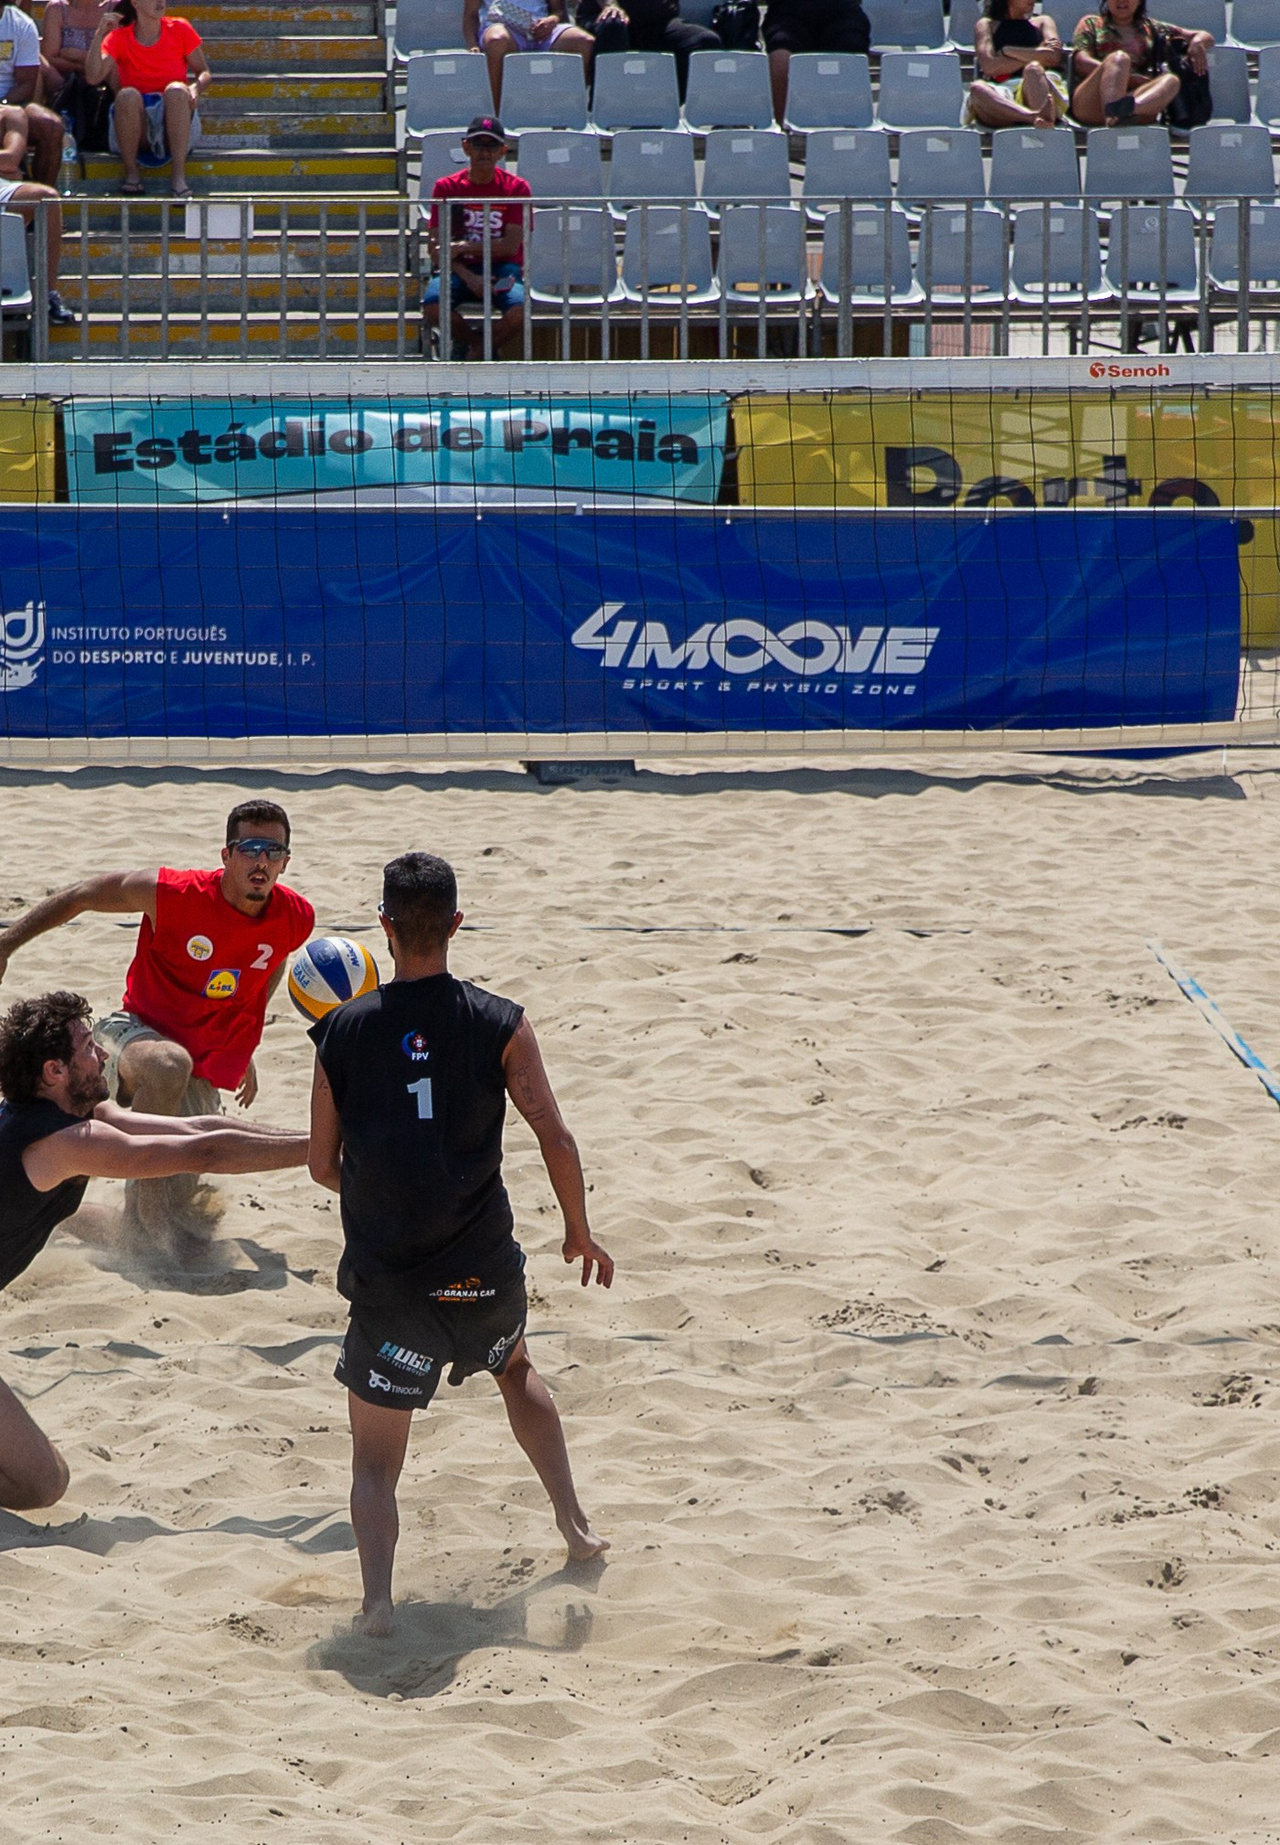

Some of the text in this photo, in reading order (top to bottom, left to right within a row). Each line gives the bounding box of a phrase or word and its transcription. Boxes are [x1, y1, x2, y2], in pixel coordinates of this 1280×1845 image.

[1108, 364, 1170, 378] Senoh
[93, 419, 699, 475] Estádio de Praia
[51, 624, 227, 641] INSTITUTO PORTUGUÊS
[52, 651, 76, 664] DO
[80, 650, 167, 665] DESPORTO
[170, 651, 179, 665] E
[182, 651, 283, 668] JUVENTUDE,
[622, 679, 704, 691] SPORT
[747, 681, 838, 694] PHYSIO
[852, 684, 917, 696] ZONE
[249, 943, 274, 970] 2
[411, 1052, 430, 1061] FPV
[406, 1077, 433, 1120] 1
[443, 1289, 478, 1298] GRANJA
[479, 1289, 496, 1297] CAR
